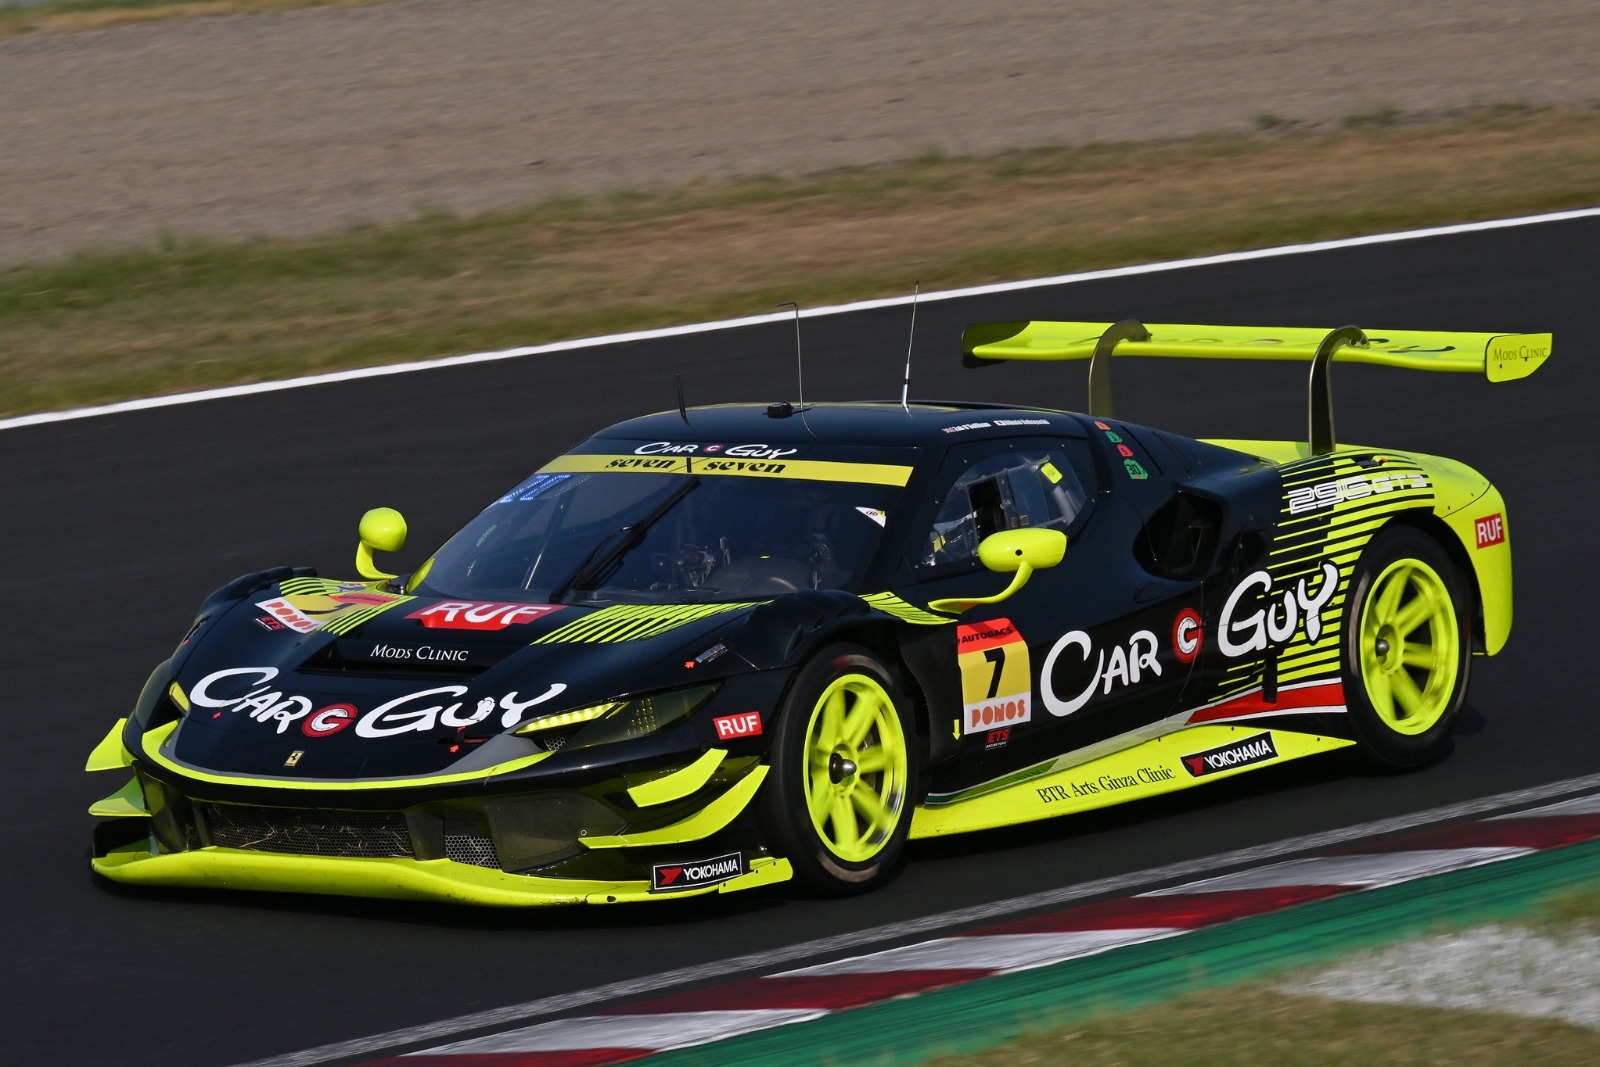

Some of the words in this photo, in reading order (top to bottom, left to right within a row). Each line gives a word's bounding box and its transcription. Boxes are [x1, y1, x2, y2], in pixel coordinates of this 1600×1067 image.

[605, 458, 677, 469] seven
[703, 459, 787, 474] seven
[1125, 464, 1142, 475] 30
[1476, 517, 1502, 544] RUF
[420, 602, 552, 625] RUF
[961, 626, 1014, 644] AUTOBACS
[983, 647, 1006, 699] 7
[971, 699, 1026, 728] PONOS
[717, 715, 758, 736] RUF
[1204, 739, 1273, 769] YOKOHAMA
[1036, 785, 1072, 804] BTR
[1070, 781, 1101, 798] Arts
[1098, 775, 1138, 791] Ginza
[1136, 765, 1177, 784] Clinic
[683, 858, 739, 881] YOKOHAMA
